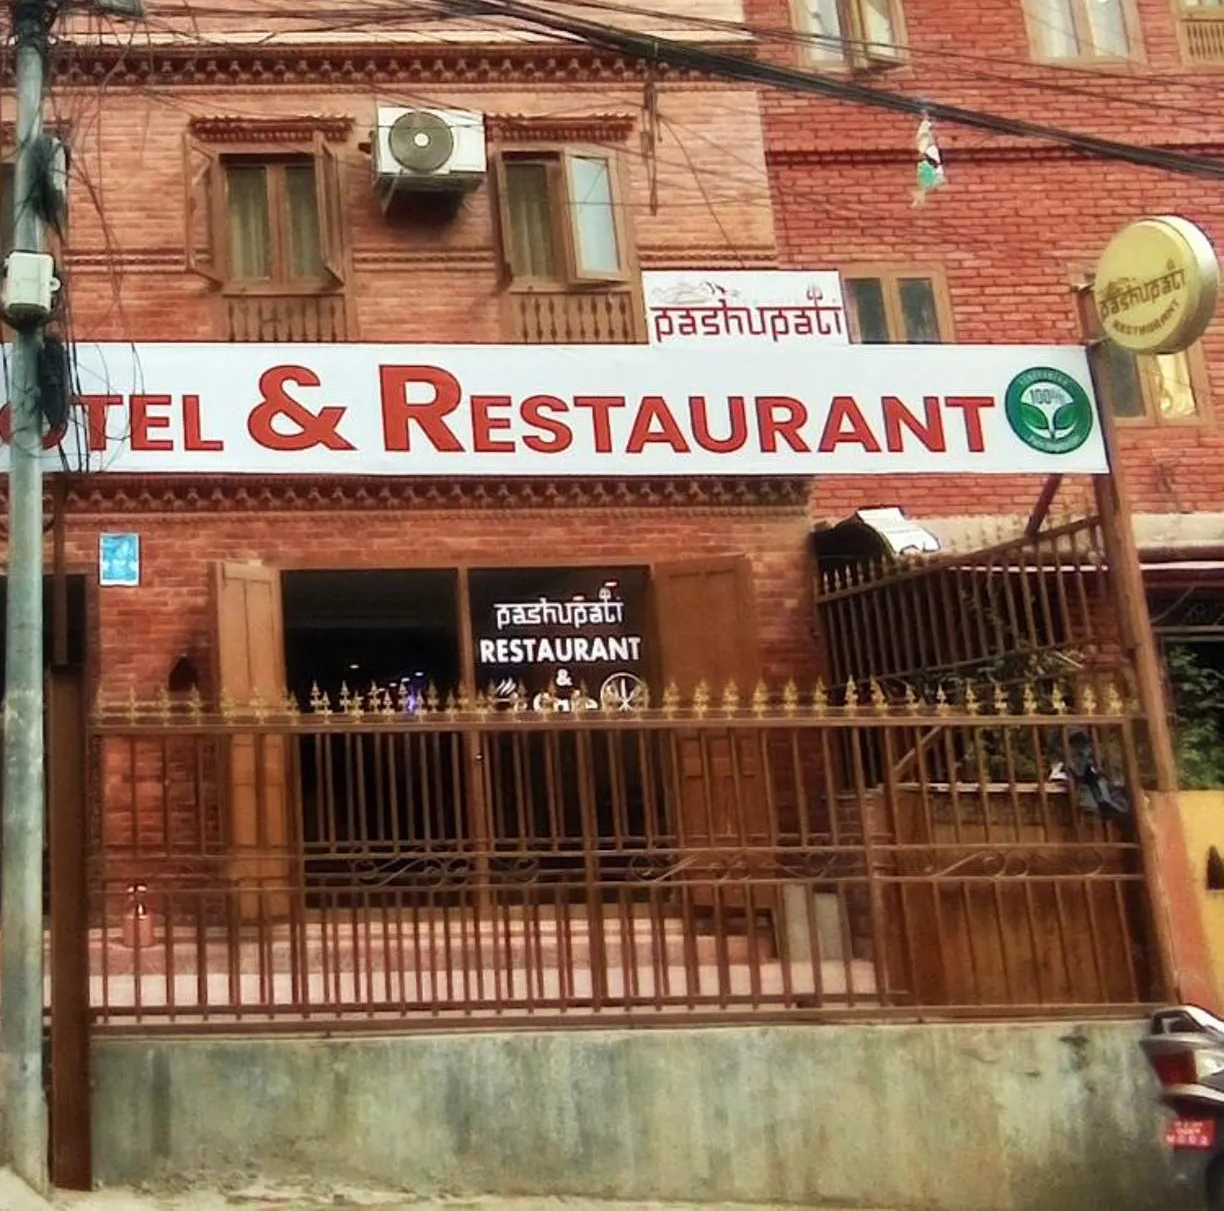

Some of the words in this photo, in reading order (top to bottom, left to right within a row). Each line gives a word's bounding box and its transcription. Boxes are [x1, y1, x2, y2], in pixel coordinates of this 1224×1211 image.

[247, 365, 356, 451] &
[379, 365, 995, 454] RESTAURANT
[479, 637, 641, 664] RESTAURANT
[555, 668, 573, 687] &
